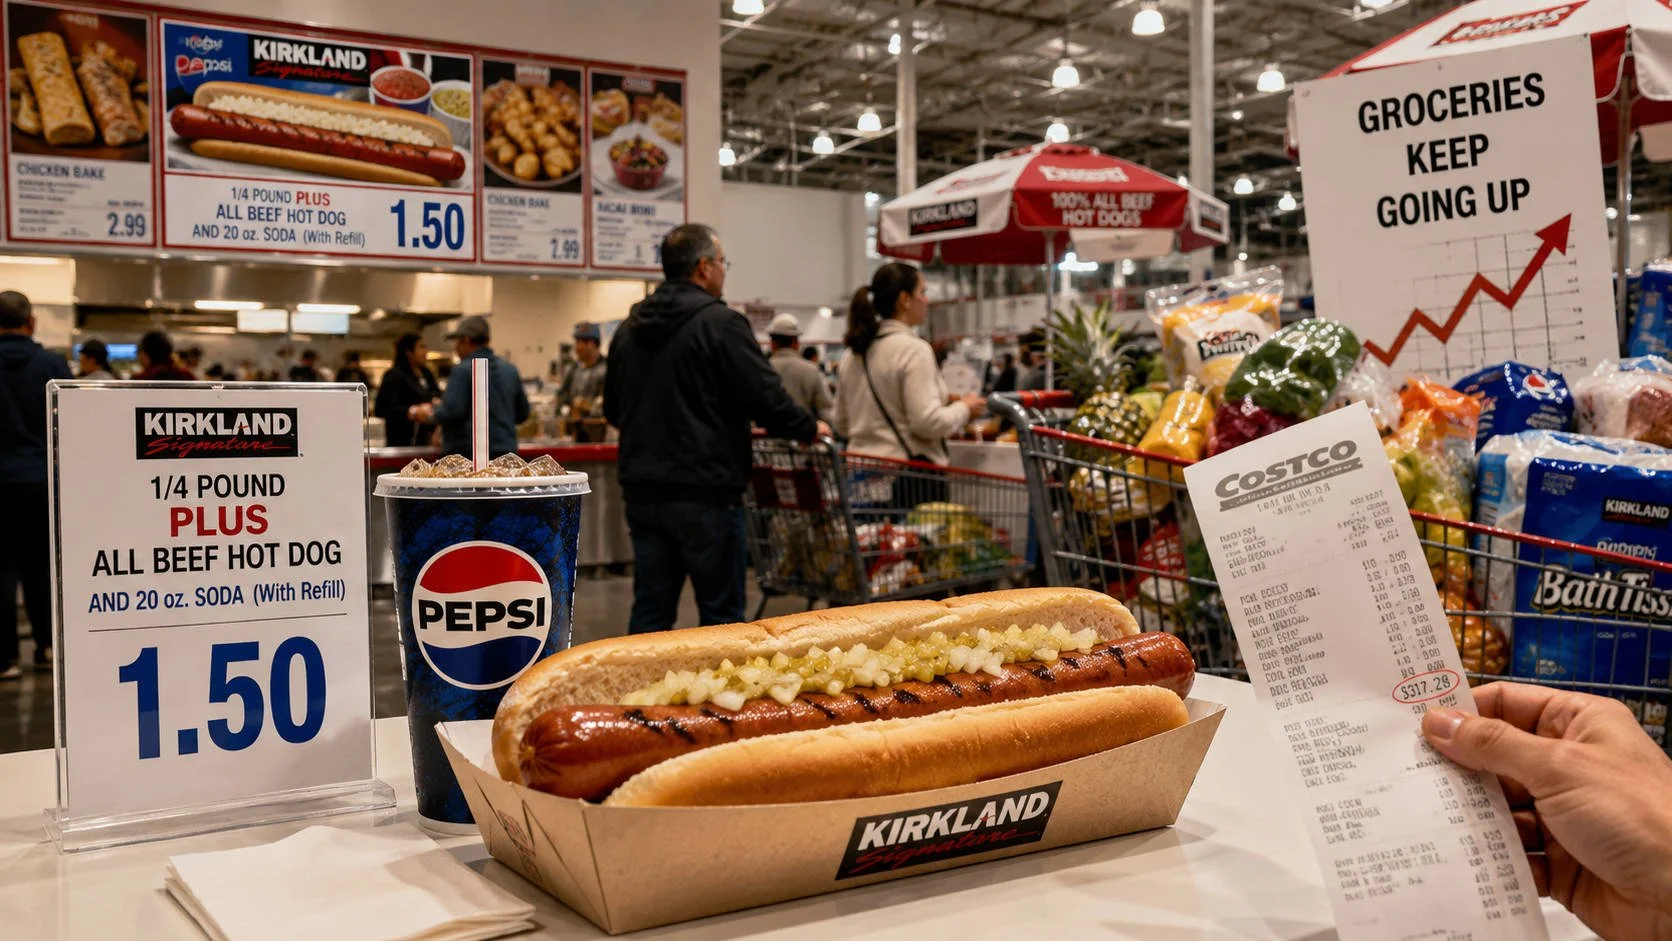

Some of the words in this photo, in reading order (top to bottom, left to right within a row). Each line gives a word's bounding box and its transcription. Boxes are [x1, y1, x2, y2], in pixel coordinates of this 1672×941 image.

[253, 39, 367, 70] KIRKLAND
[1358, 73, 1545, 134] GROCERIES
[17, 162, 69, 177] CHICKEN
[1406, 134, 1489, 175] KEEP
[231, 187, 249, 201] 1/4
[252, 189, 292, 204] POUND
[296, 191, 331, 206] PLUS
[1051, 192, 1091, 209] 100%
[1093, 193, 1119, 209] ALL
[1121, 192, 1155, 210] BEEF
[1377, 185, 1477, 228] GOING
[1487, 178, 1531, 212] UP
[107, 212, 146, 237] 2.99
[216, 204, 243, 220] ALL
[247, 206, 282, 222] BEEF
[287, 208, 316, 224] HOT
[318, 210, 346, 226] DOG
[390, 199, 465, 250] 1.50
[1062, 210, 1095, 225] HOT
[1097, 210, 1141, 227] DOGS
[192, 224, 219, 239] AND
[223, 225, 239, 239] 20
[263, 227, 296, 242] SODA
[303, 229, 331, 244] (With
[335, 231, 366, 248] Refill)
[144, 412, 292, 436] KIRKLAND
[1215, 440, 1358, 499] COSTCO
[150, 475, 188, 500] 1/4
[197, 473, 286, 498] POUND
[169, 504, 269, 537] PLUS
[1605, 499, 1670, 519] KIRKLAND
[91, 549, 144, 577] ALL
[153, 545, 219, 574] BEEF
[227, 542, 281, 570] HOT
[287, 540, 342, 568] DOG
[88, 591, 129, 613] AND
[136, 590, 159, 610] 20
[163, 593, 189, 609] oz.
[194, 585, 244, 607] SODA
[253, 583, 296, 607] (With
[301, 579, 346, 602] Refill)
[1533, 567, 1618, 612] Bath
[1620, 572, 1672, 617] Tiss
[417, 596, 545, 632] PEPSI
[118, 636, 327, 760] 1.50
[858, 791, 1050, 851] KIRKLAND
[848, 828, 1037, 874] Signature
